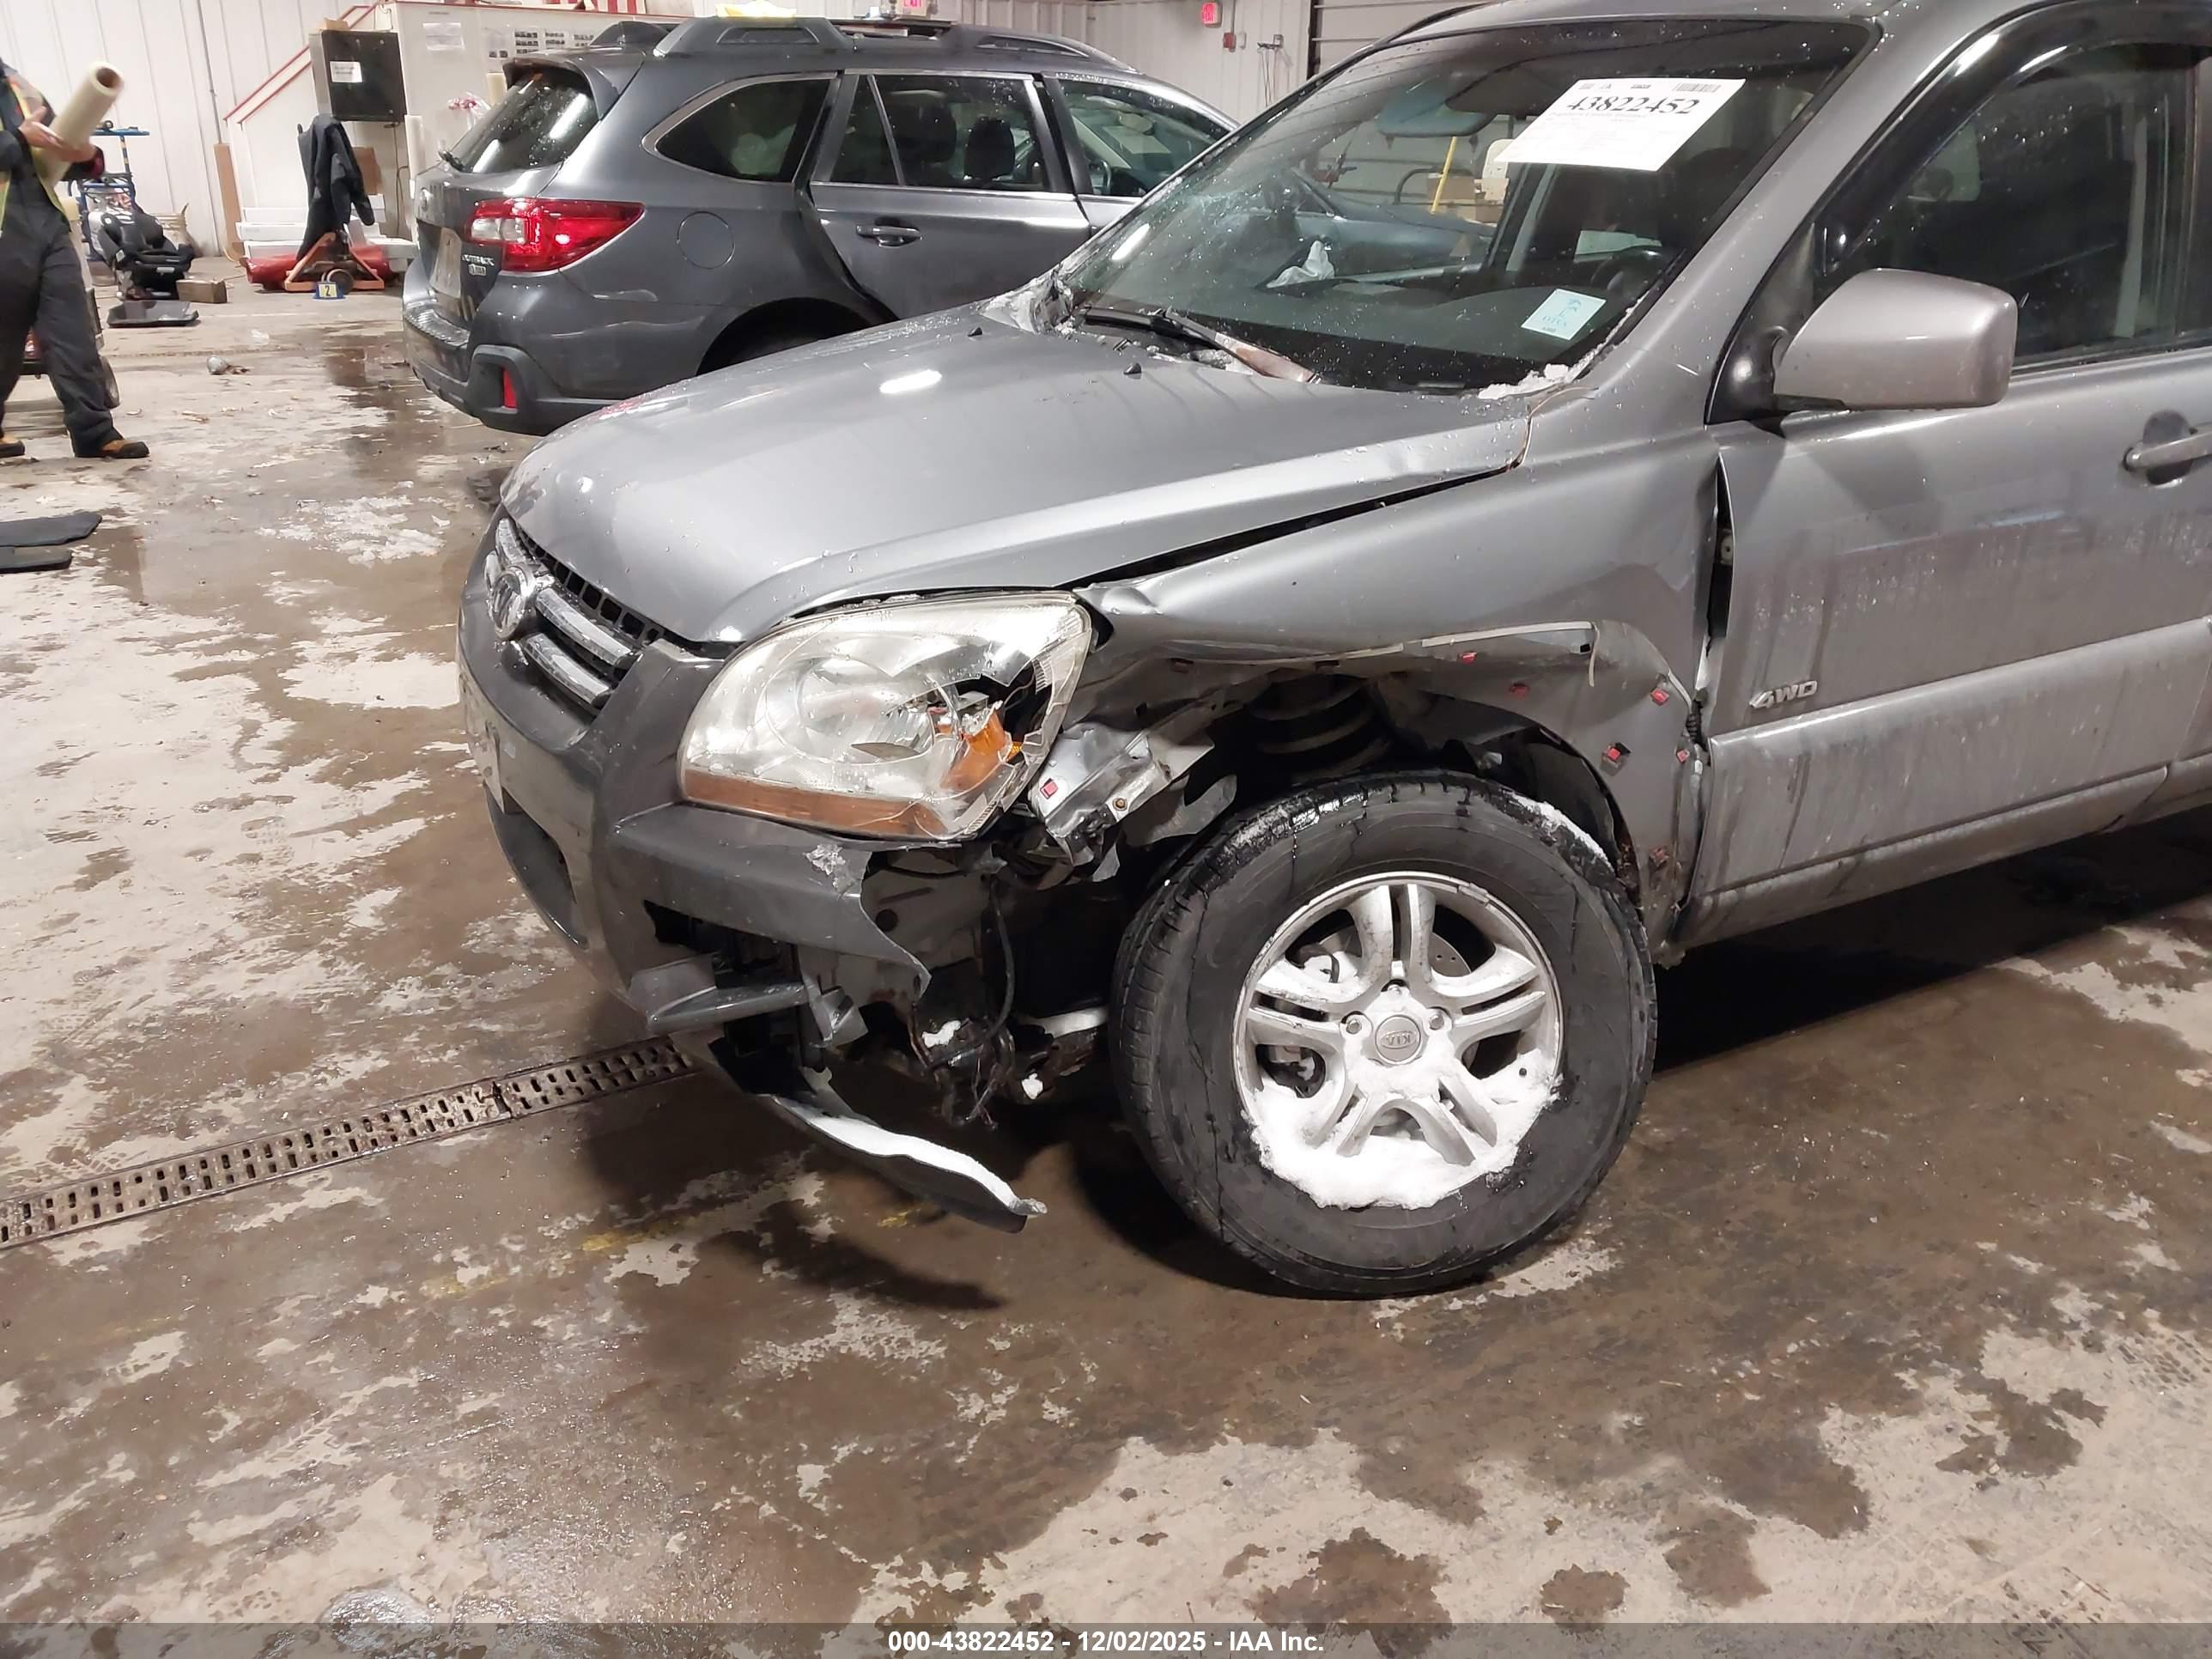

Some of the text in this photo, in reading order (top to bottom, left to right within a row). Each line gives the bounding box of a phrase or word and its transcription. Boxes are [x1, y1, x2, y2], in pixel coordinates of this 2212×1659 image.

[1567, 96, 1700, 114] 43822452
[325, 285, 331, 296] 2
[1748, 680, 1818, 708] 4WD
[1386, 1033, 1411, 1045] KIA
